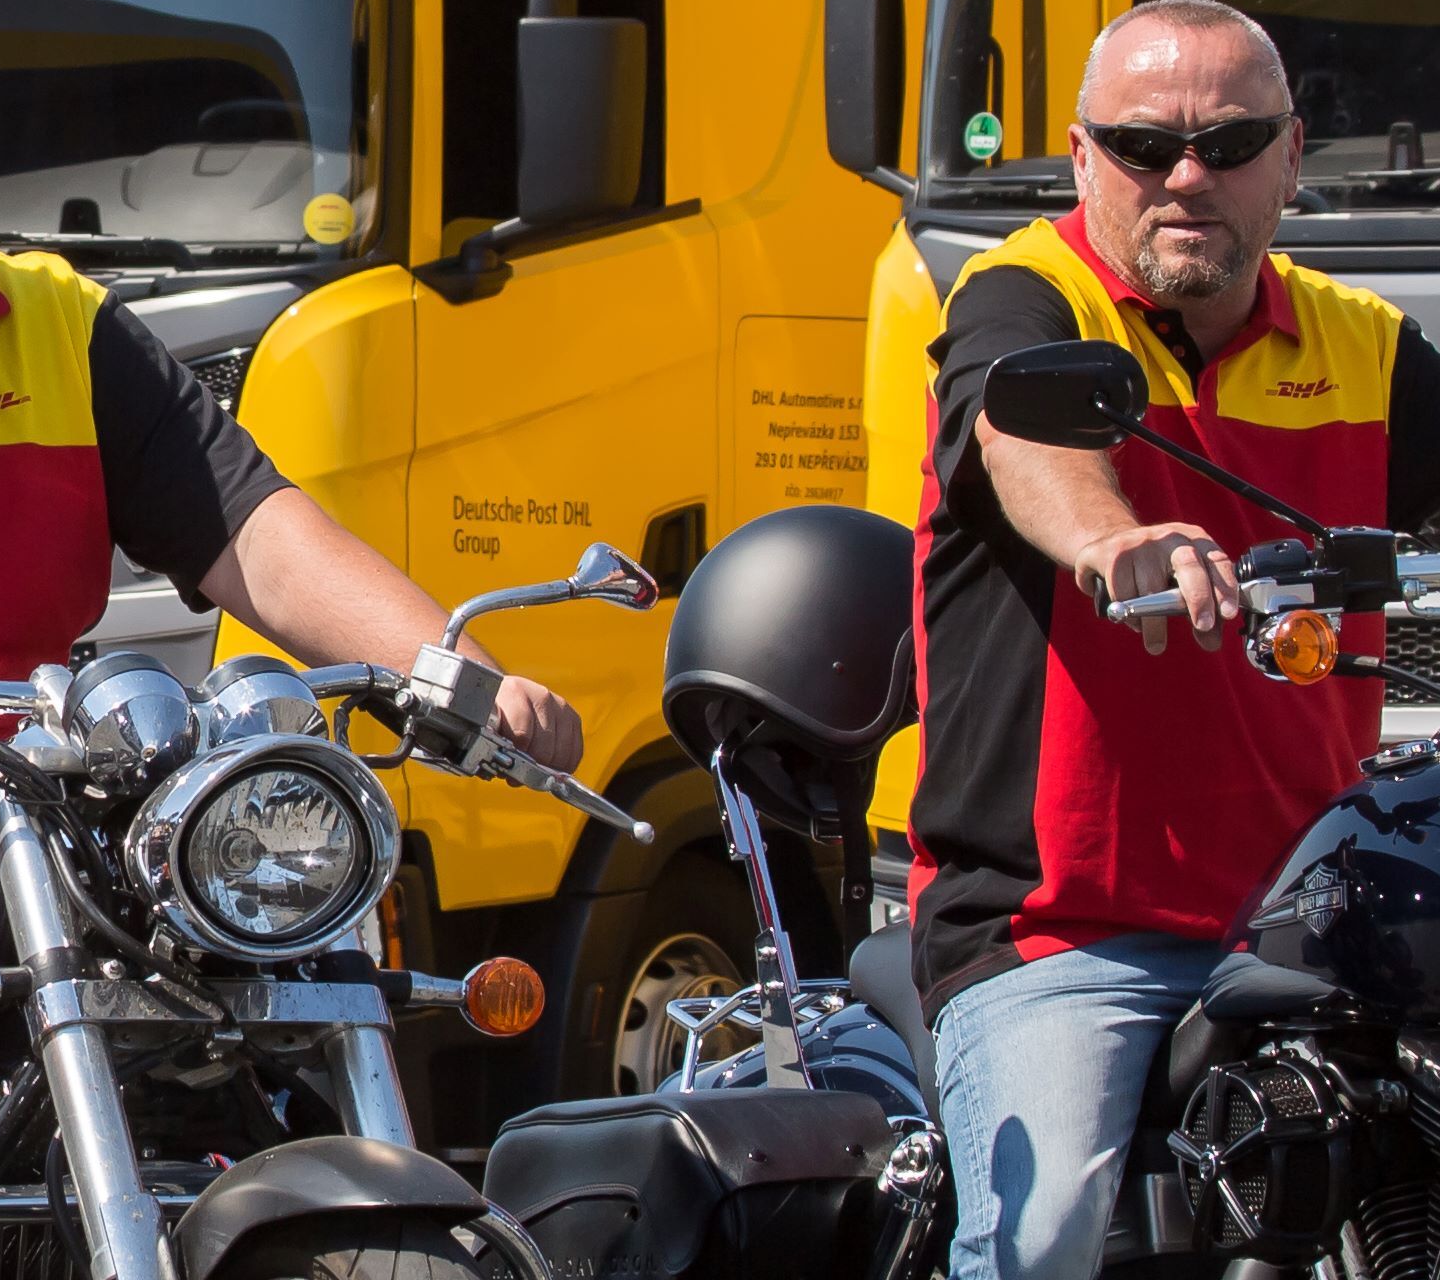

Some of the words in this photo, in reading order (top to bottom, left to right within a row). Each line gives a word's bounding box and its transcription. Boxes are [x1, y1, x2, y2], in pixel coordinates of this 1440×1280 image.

[1277, 377, 1334, 398] DHL
[752, 389, 775, 406] DHL
[779, 392, 844, 409] Automotive
[755, 452, 776, 468] 293
[798, 450, 868, 472] NEPŘEVÁZK
[453, 495, 524, 523] Deutsche
[527, 499, 558, 524] Post
[563, 501, 592, 527] DHL
[453, 529, 500, 561] Group
